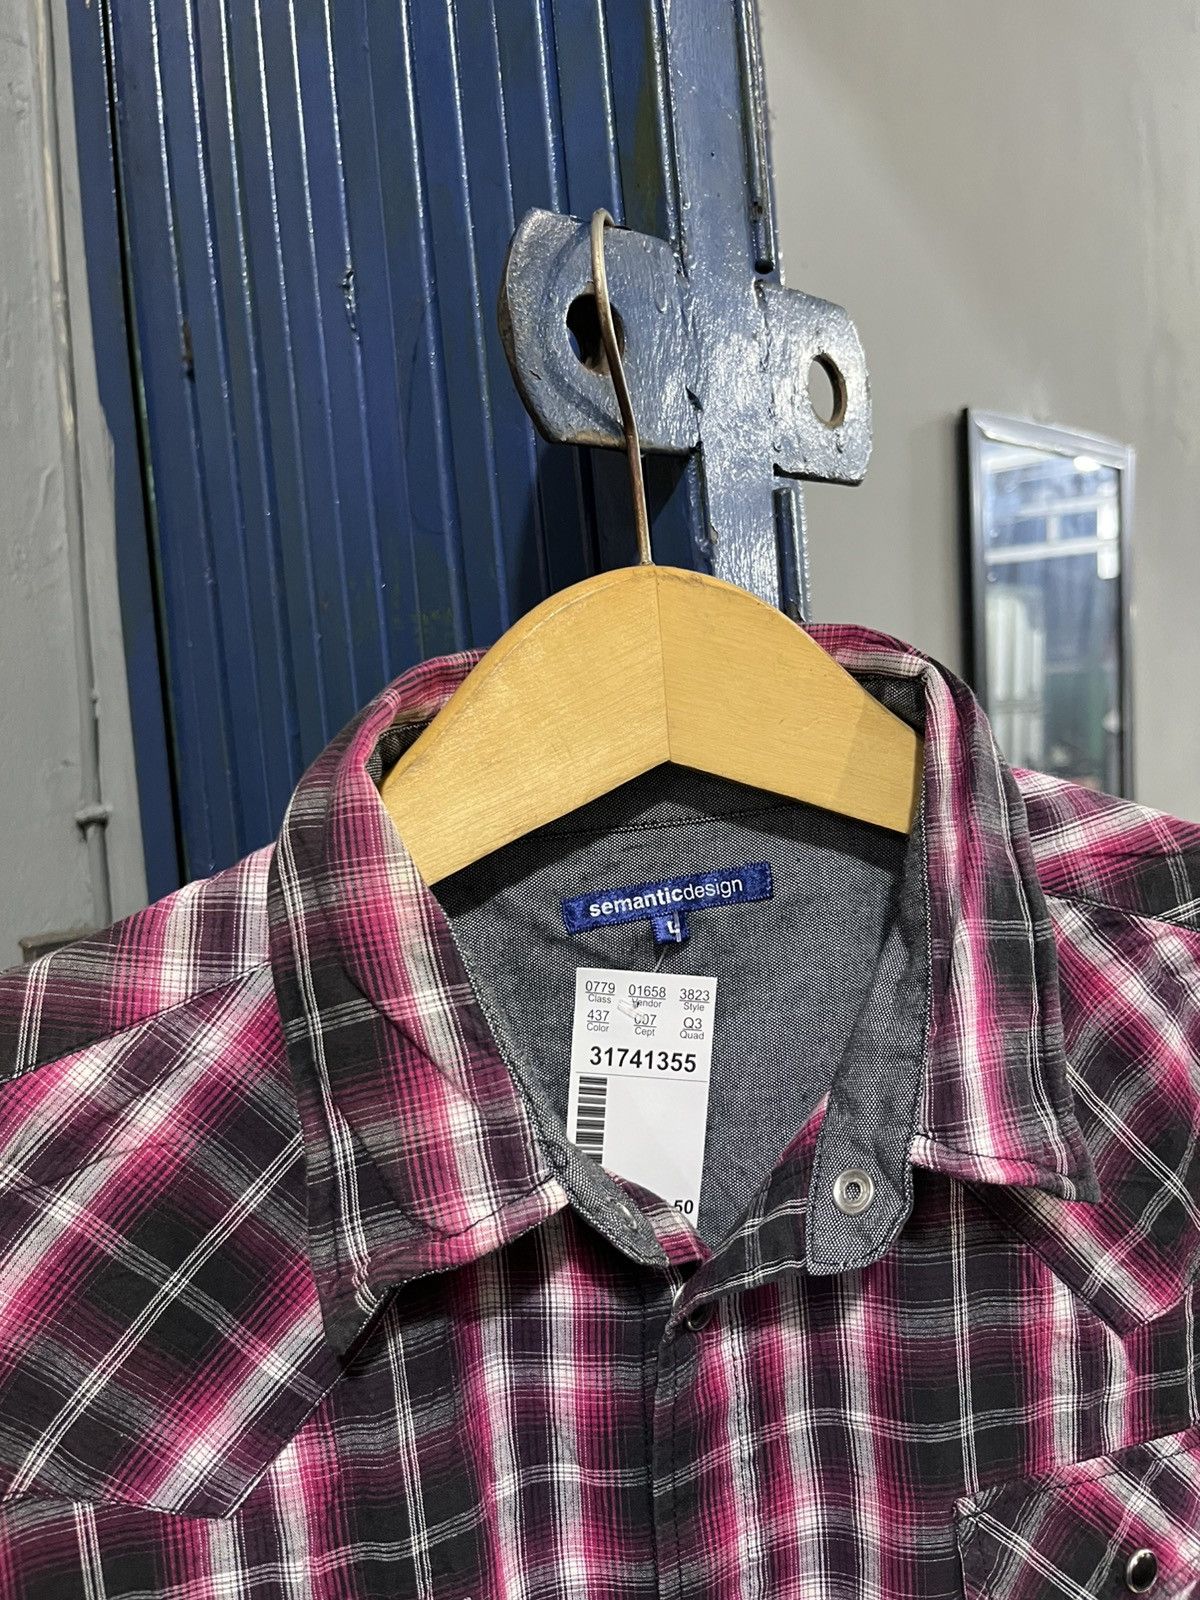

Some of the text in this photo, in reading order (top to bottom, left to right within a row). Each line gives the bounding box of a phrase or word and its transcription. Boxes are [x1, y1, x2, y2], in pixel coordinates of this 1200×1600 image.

[589, 878, 743, 917] semanticdesign
[585, 980, 616, 994] 0779
[628, 984, 667, 998] 01658
[588, 993, 612, 1004] Class
[679, 988, 710, 1001] 3823
[683, 1001, 705, 1013] Style
[587, 1009, 610, 1022] 437
[586, 1022, 610, 1032] Color
[683, 1017, 703, 1030] Q3
[634, 1026, 655, 1037] Cept
[679, 1029, 705, 1040] Quad
[589, 1045, 697, 1073] 31741355
